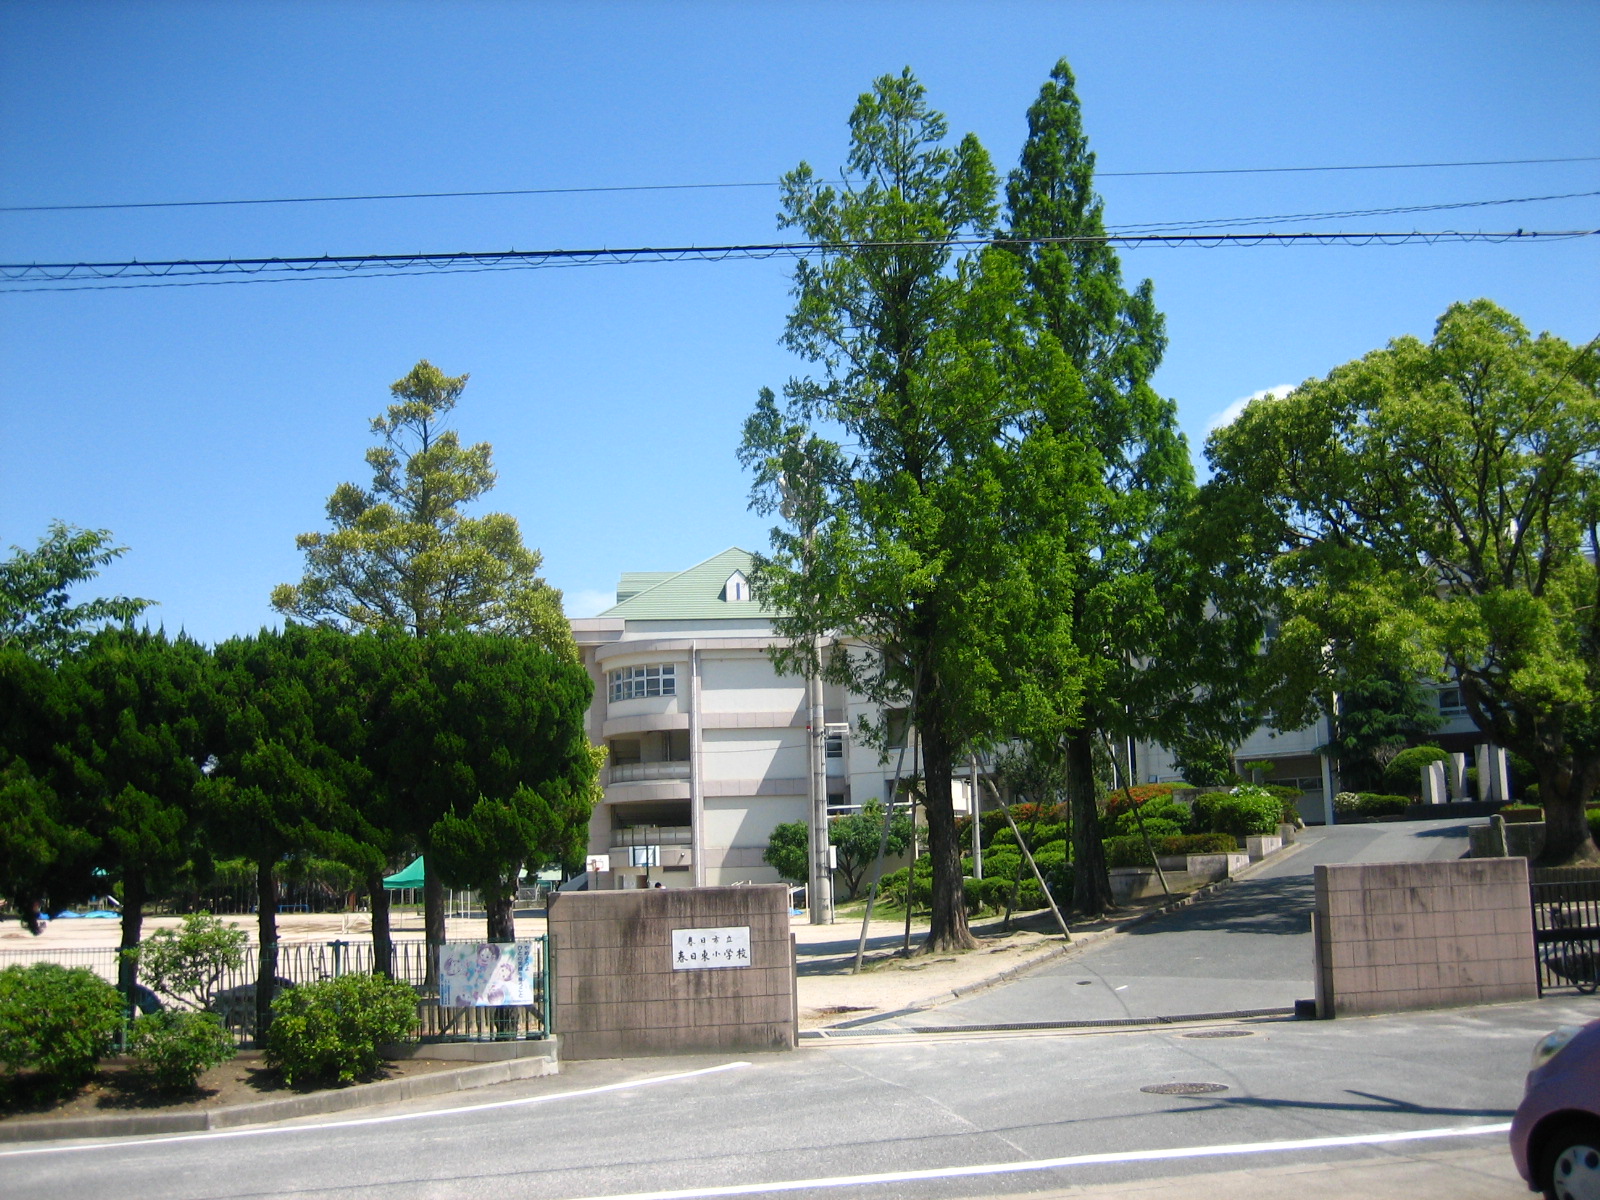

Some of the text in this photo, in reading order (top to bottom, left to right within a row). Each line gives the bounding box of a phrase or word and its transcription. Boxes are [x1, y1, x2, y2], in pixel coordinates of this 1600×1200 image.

[686, 935, 733, 947] 春日市立
[677, 948, 747, 963] 春日東小学校
